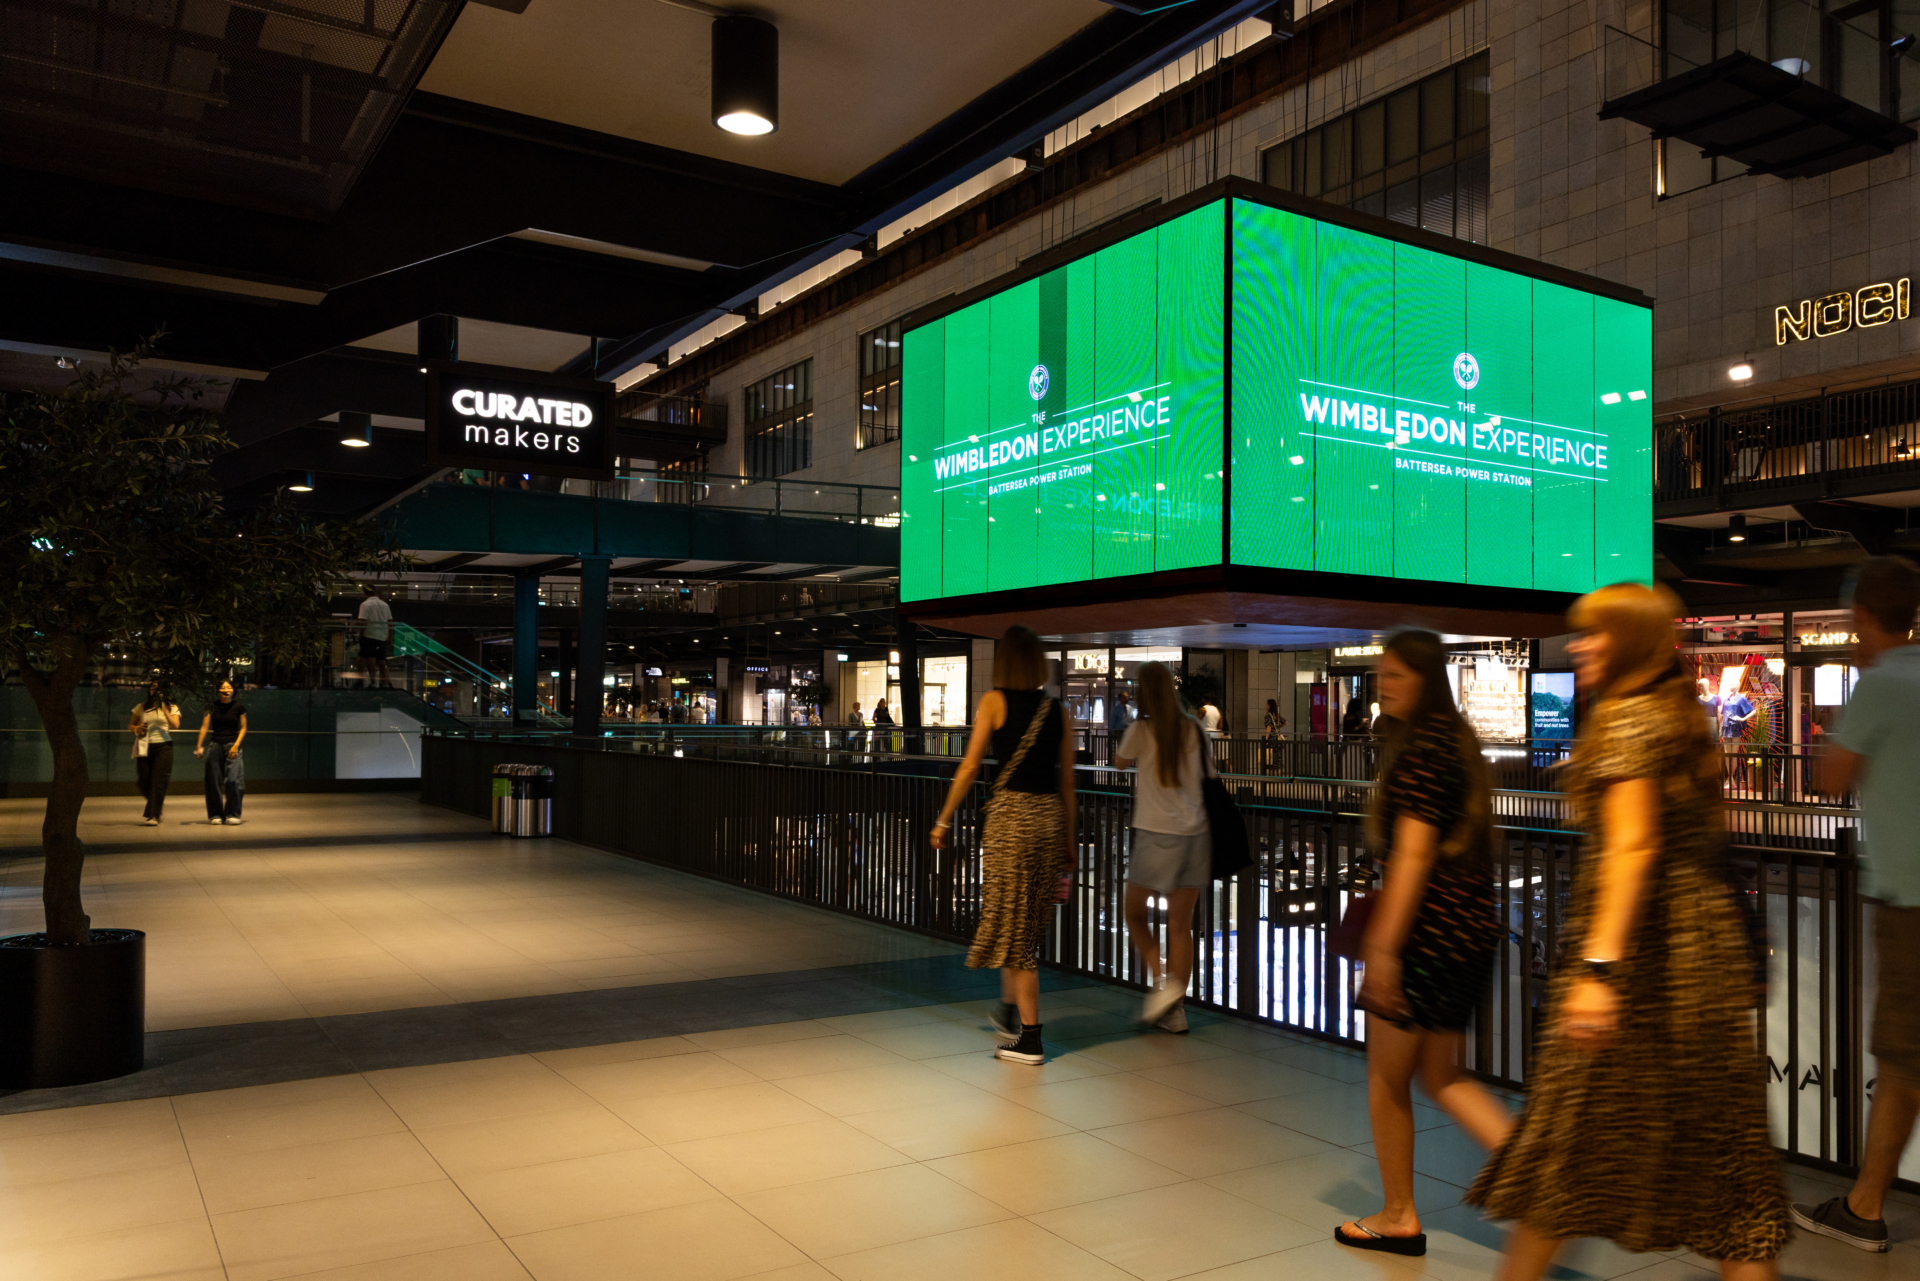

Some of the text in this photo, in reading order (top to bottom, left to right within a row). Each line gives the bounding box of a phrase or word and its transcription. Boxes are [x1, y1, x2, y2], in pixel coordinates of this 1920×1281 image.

[1775, 277, 1910, 345] NOCI
[451, 388, 593, 428] CURATED
[1031, 411, 1046, 423] THE
[1457, 401, 1476, 414] THE
[465, 425, 580, 453] makers
[934, 396, 1170, 480] WIMBLEDON EXPERIENCE
[1300, 393, 1608, 469] WIMBLEDON EXPERIENCE
[988, 464, 1092, 495] BATTERSEA POWER STATION
[1395, 458, 1531, 486] BATTERSEA POWER STATION
[1801, 632, 1848, 645] SCAMP
